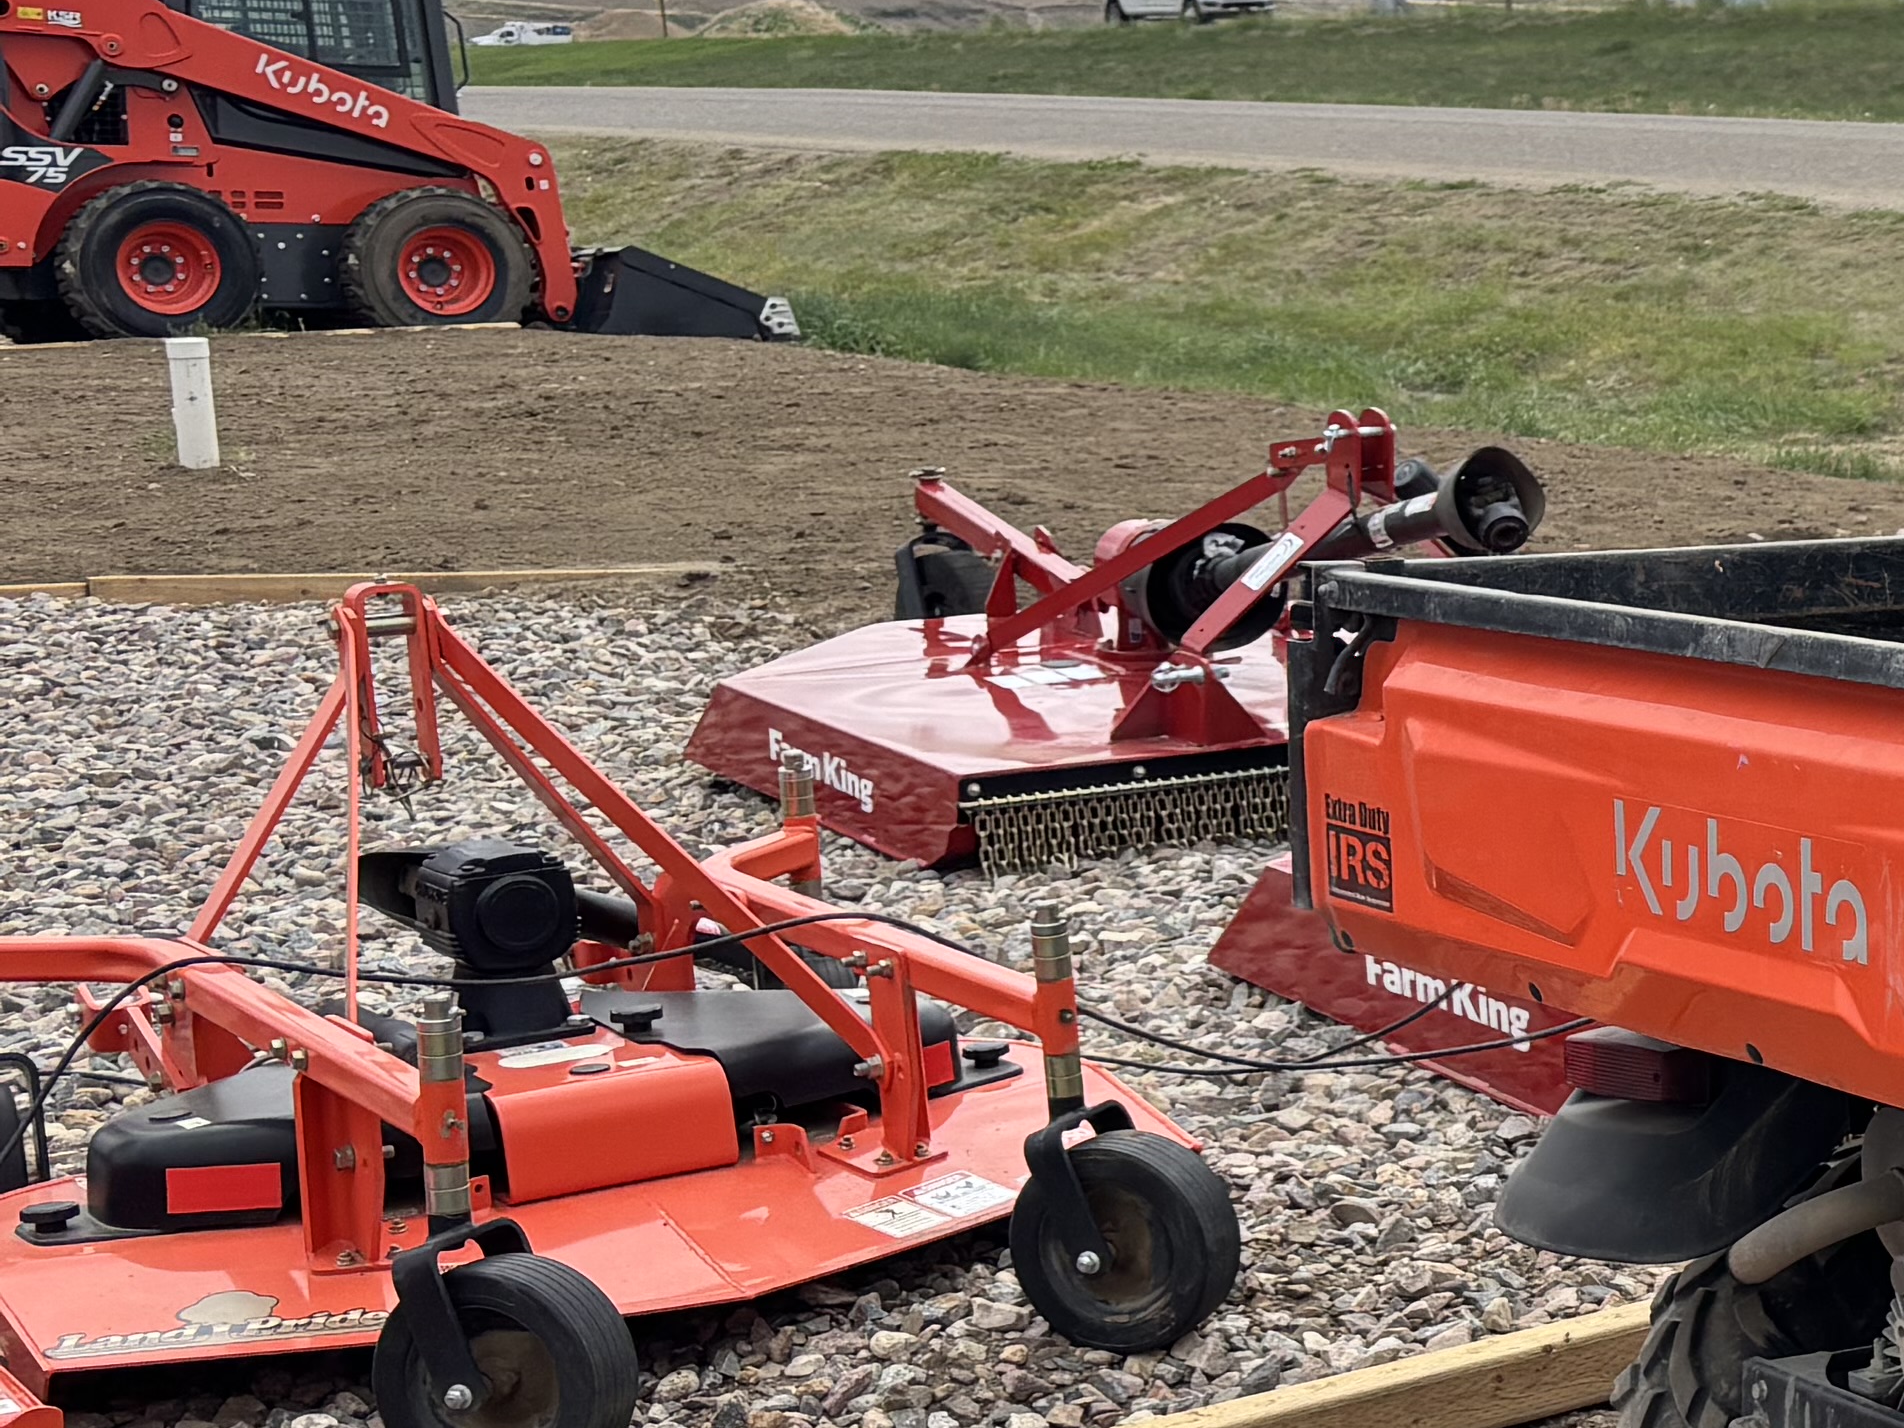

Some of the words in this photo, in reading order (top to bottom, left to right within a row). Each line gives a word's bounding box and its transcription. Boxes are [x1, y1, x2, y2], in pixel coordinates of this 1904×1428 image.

[255, 53, 389, 128] Kubota
[0, 146, 84, 167] SSV
[25, 167, 69, 183] 75
[822, 751, 875, 814] King
[1325, 792, 1357, 826] Extra
[1358, 800, 1390, 837] Duty
[1328, 829, 1390, 890] IRS
[1613, 798, 1869, 965] Kubota
[1451, 978, 1532, 1054] King
